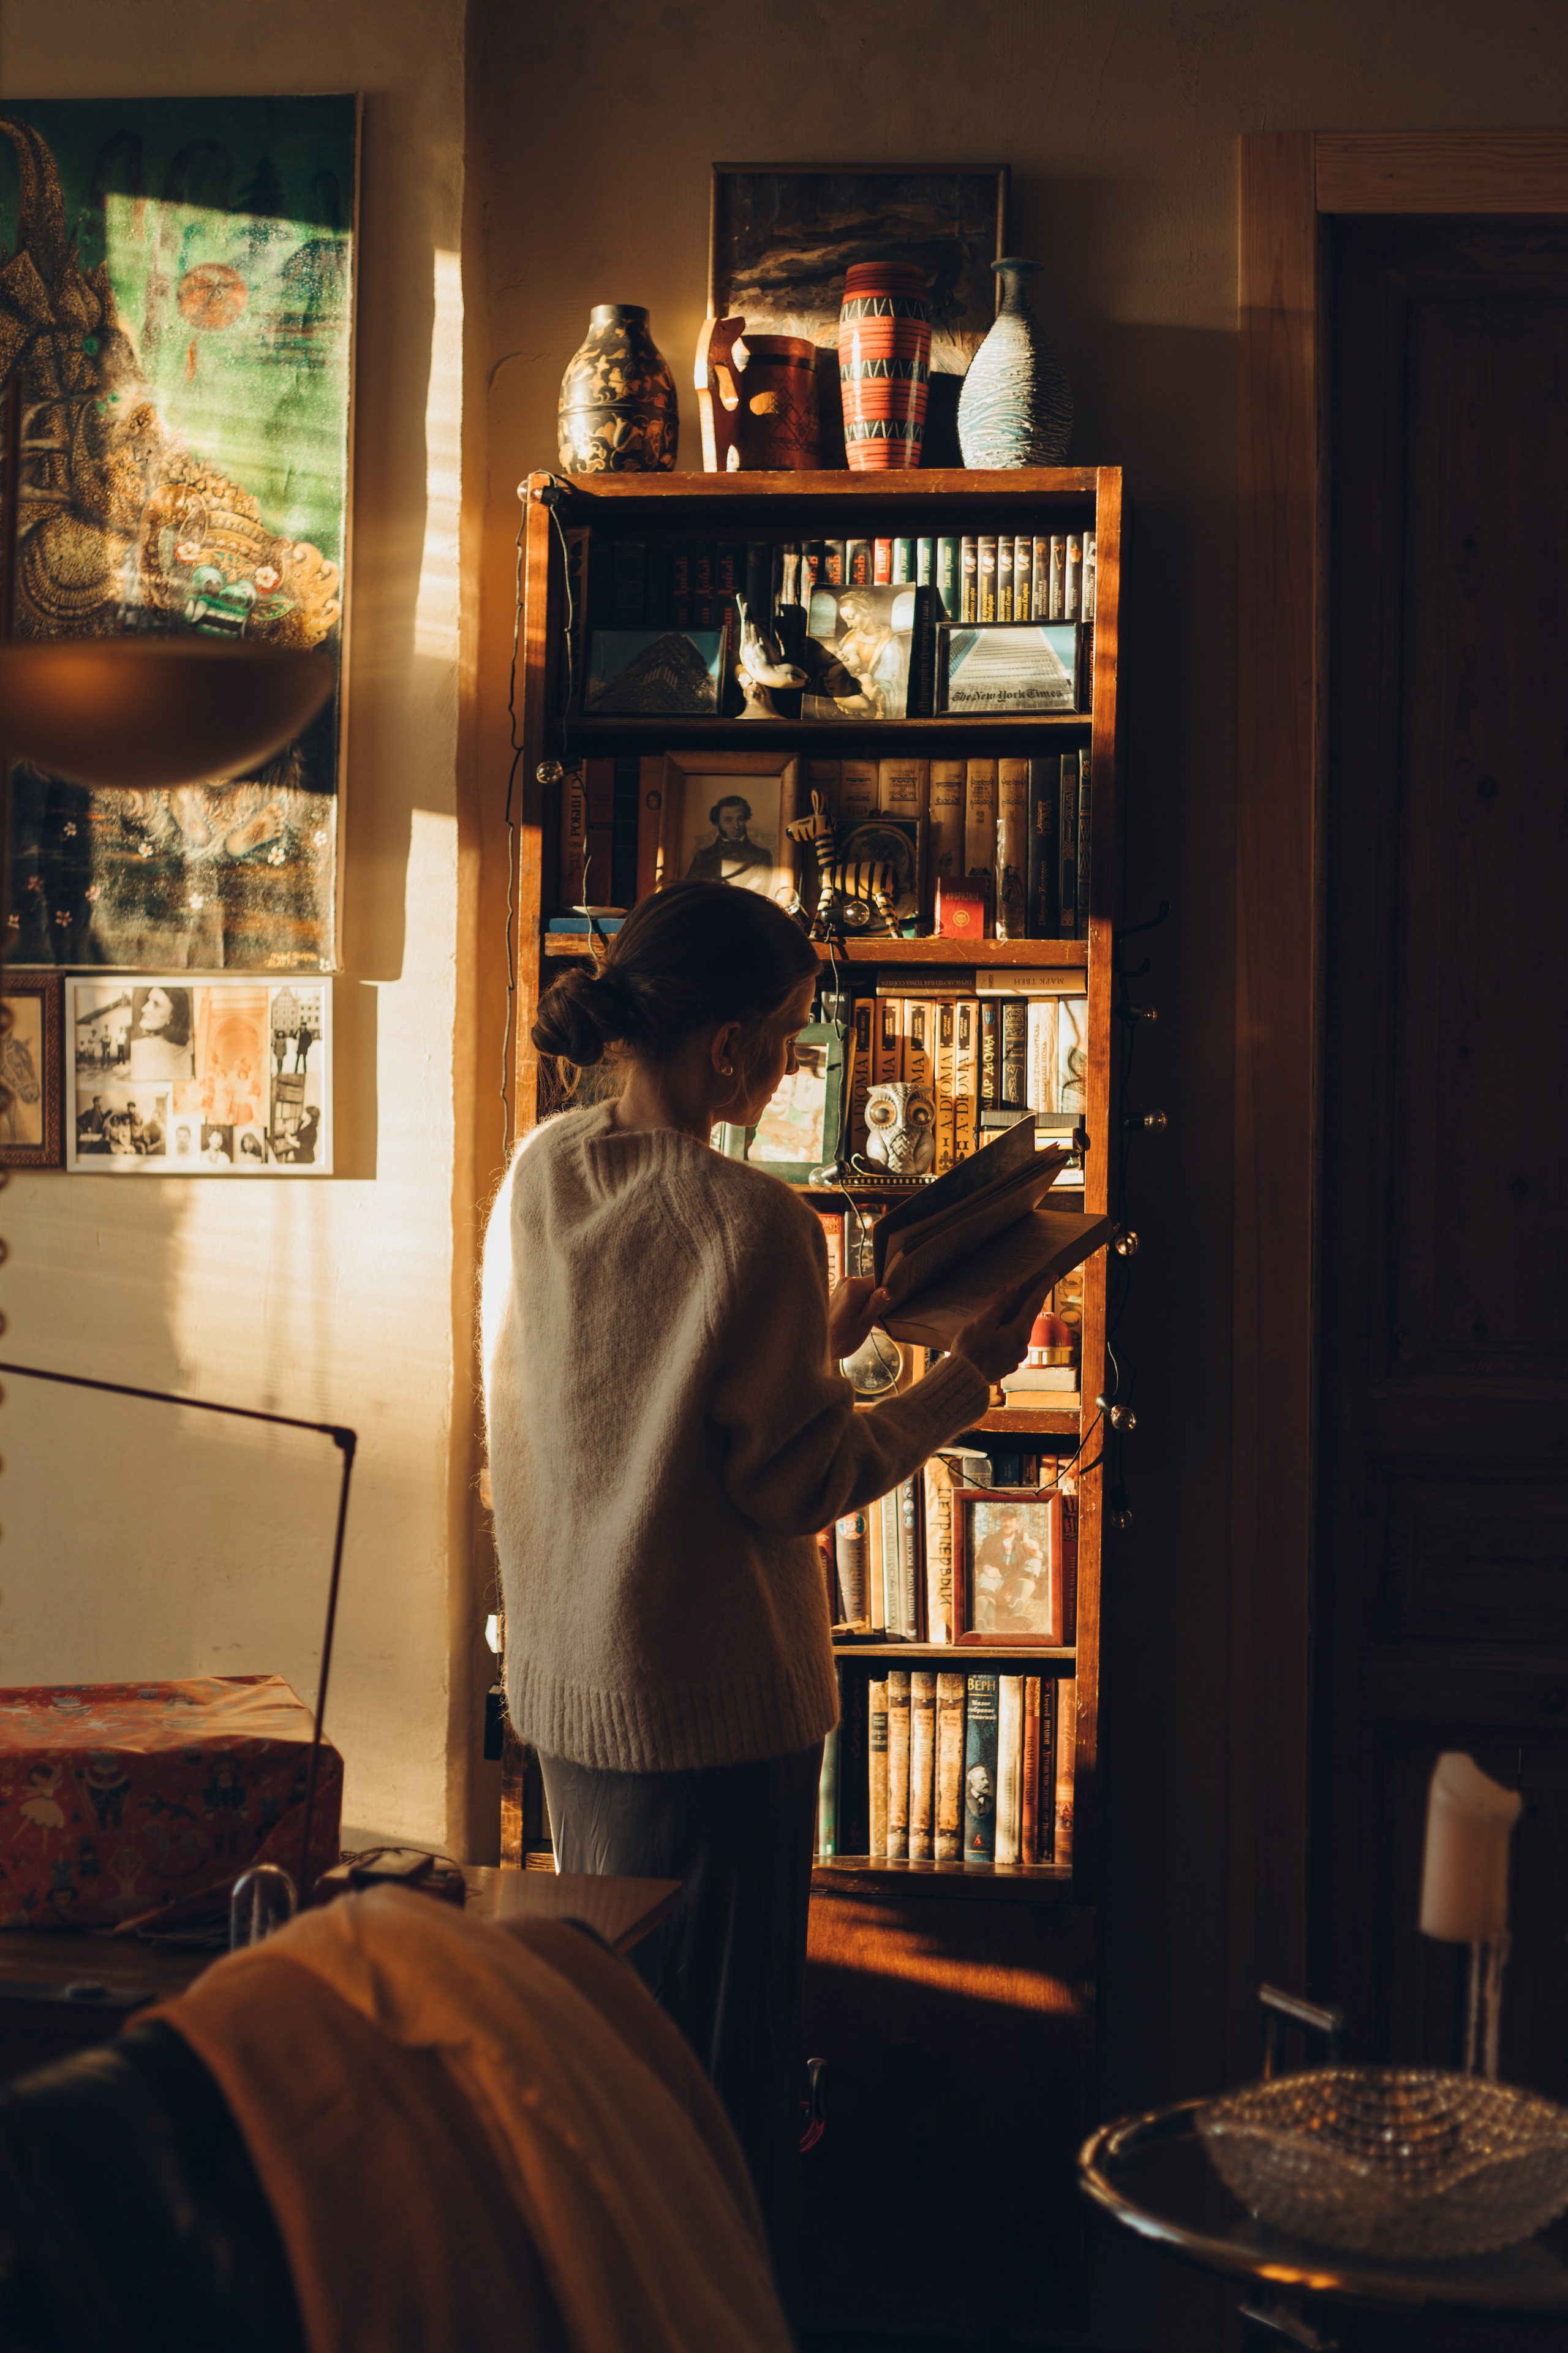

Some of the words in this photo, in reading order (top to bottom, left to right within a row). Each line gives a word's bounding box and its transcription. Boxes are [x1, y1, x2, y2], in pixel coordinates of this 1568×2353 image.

[952, 690, 970, 702] The
[972, 690, 996, 701] New
[997, 690, 1025, 703] York
[1026, 688, 1063, 699] Times
[570, 795, 581, 837] РОБИН
[945, 890, 979, 901] АФОРИЗМЫ
[982, 1034, 995, 1076] ДЮМА
[885, 1520, 896, 1579] СКИПЕТРОМ
[905, 1535, 914, 1566] РОССИИ
[905, 1569, 916, 1622] ИМПЕРАТОРЫ
[967, 1677, 996, 1691] ВЕРН
[1026, 1736, 1035, 1761] ИВАН
[1025, 1762, 1035, 1806] ГРОЗНЫЙ
